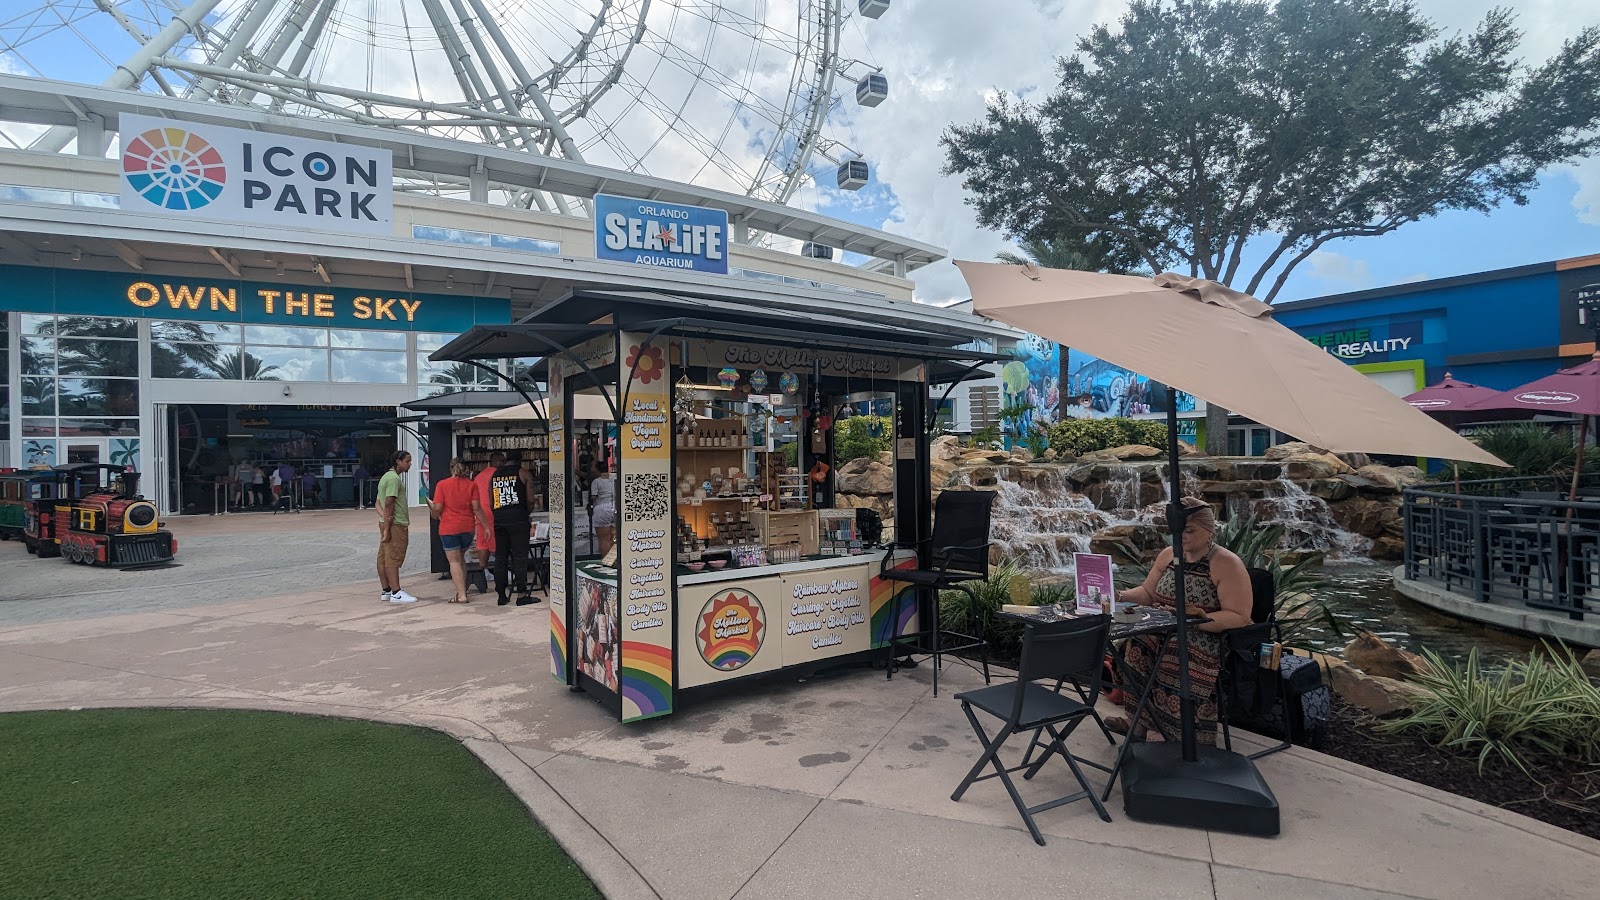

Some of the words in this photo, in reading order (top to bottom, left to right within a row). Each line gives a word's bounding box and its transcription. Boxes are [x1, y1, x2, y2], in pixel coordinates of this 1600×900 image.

[243, 142, 377, 187] ICON
[243, 179, 378, 221] PARK
[638, 206, 688, 220] ORLANDO
[605, 213, 664, 251] SEA
[635, 255, 693, 269] AQUARIUM
[127, 282, 237, 312] OWN
[258, 290, 335, 317] THE
[352, 296, 422, 321] SKY
[1304, 328, 1370, 346] REME
[1338, 337, 1412, 356] REALITY
[725, 344, 761, 364] The
[833, 353, 891, 373] Market
[633, 399, 659, 411] Local
[632, 422, 660, 439] Vegan
[630, 437, 662, 452] Organic
[492, 480, 517, 488] DON'T
[627, 529, 665, 541] Rainbow
[630, 540, 662, 552] Makers
[630, 557, 664, 569] Earrings
[630, 572, 663, 586] Crystals
[793, 582, 830, 599] Rainbow
[830, 579, 858, 594] Makers
[626, 603, 651, 616] Body
[651, 601, 667, 612] Oils
[726, 609, 738, 617] The
[791, 601, 825, 617] Earrings
[830, 595, 861, 613] Crystals
[631, 617, 664, 631] Candles
[713, 616, 751, 629] Mellow
[787, 620, 822, 635] Haircare
[827, 614, 849, 630] Body
[850, 611, 865, 625] Oils
[715, 626, 749, 639] Market
[812, 633, 843, 649] Candles
